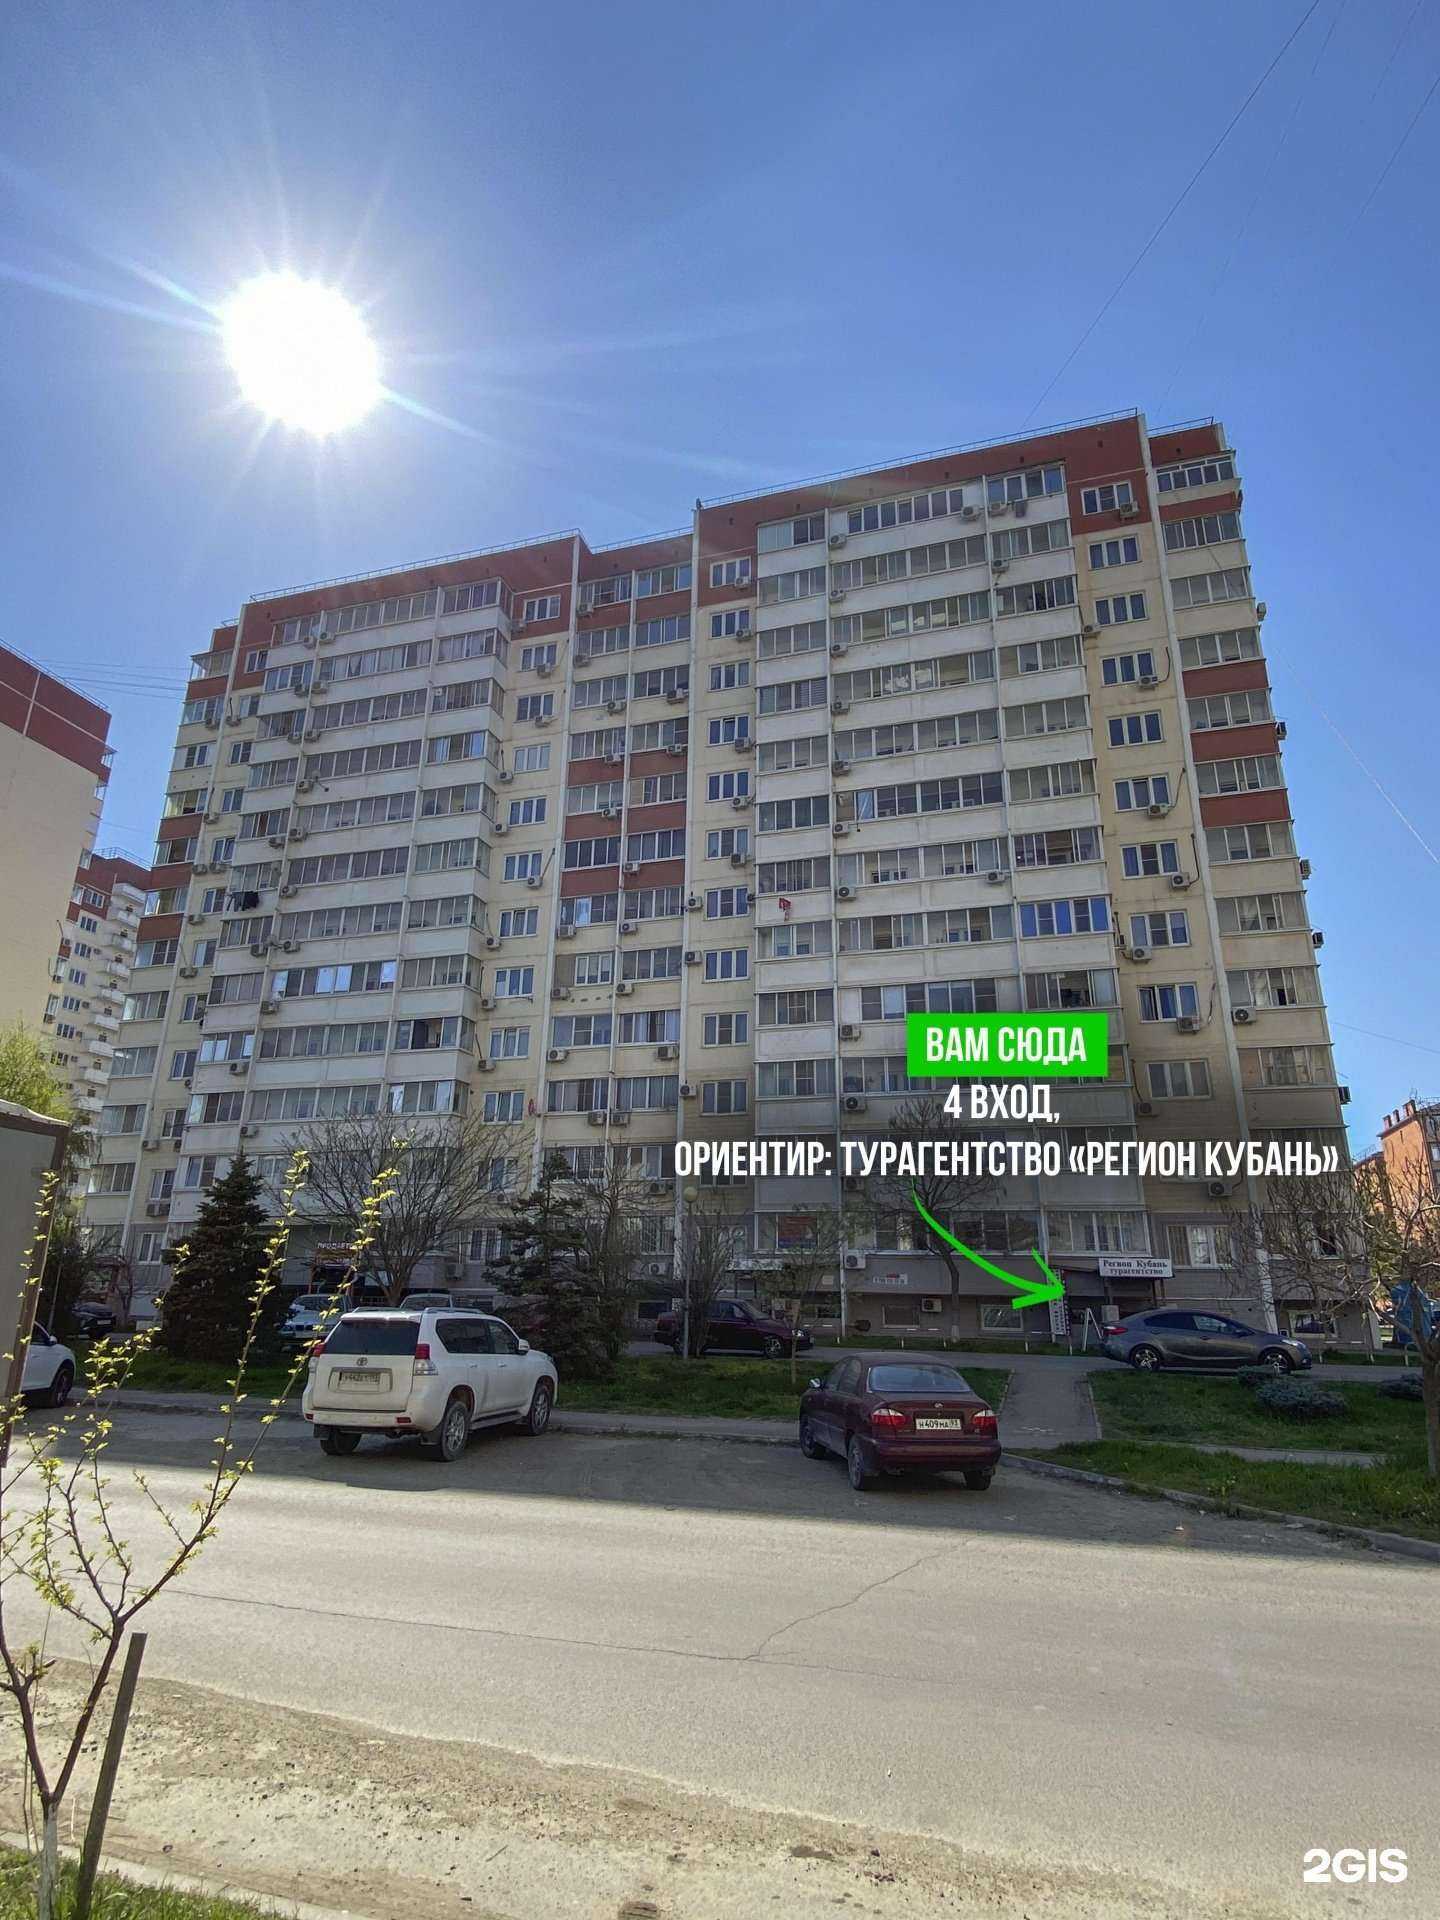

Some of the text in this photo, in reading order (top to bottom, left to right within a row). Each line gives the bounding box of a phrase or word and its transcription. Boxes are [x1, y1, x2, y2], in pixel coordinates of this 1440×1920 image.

[1103, 1259, 1168, 1269] Регион Кубань
[1110, 1268, 1164, 1276] турагентство
